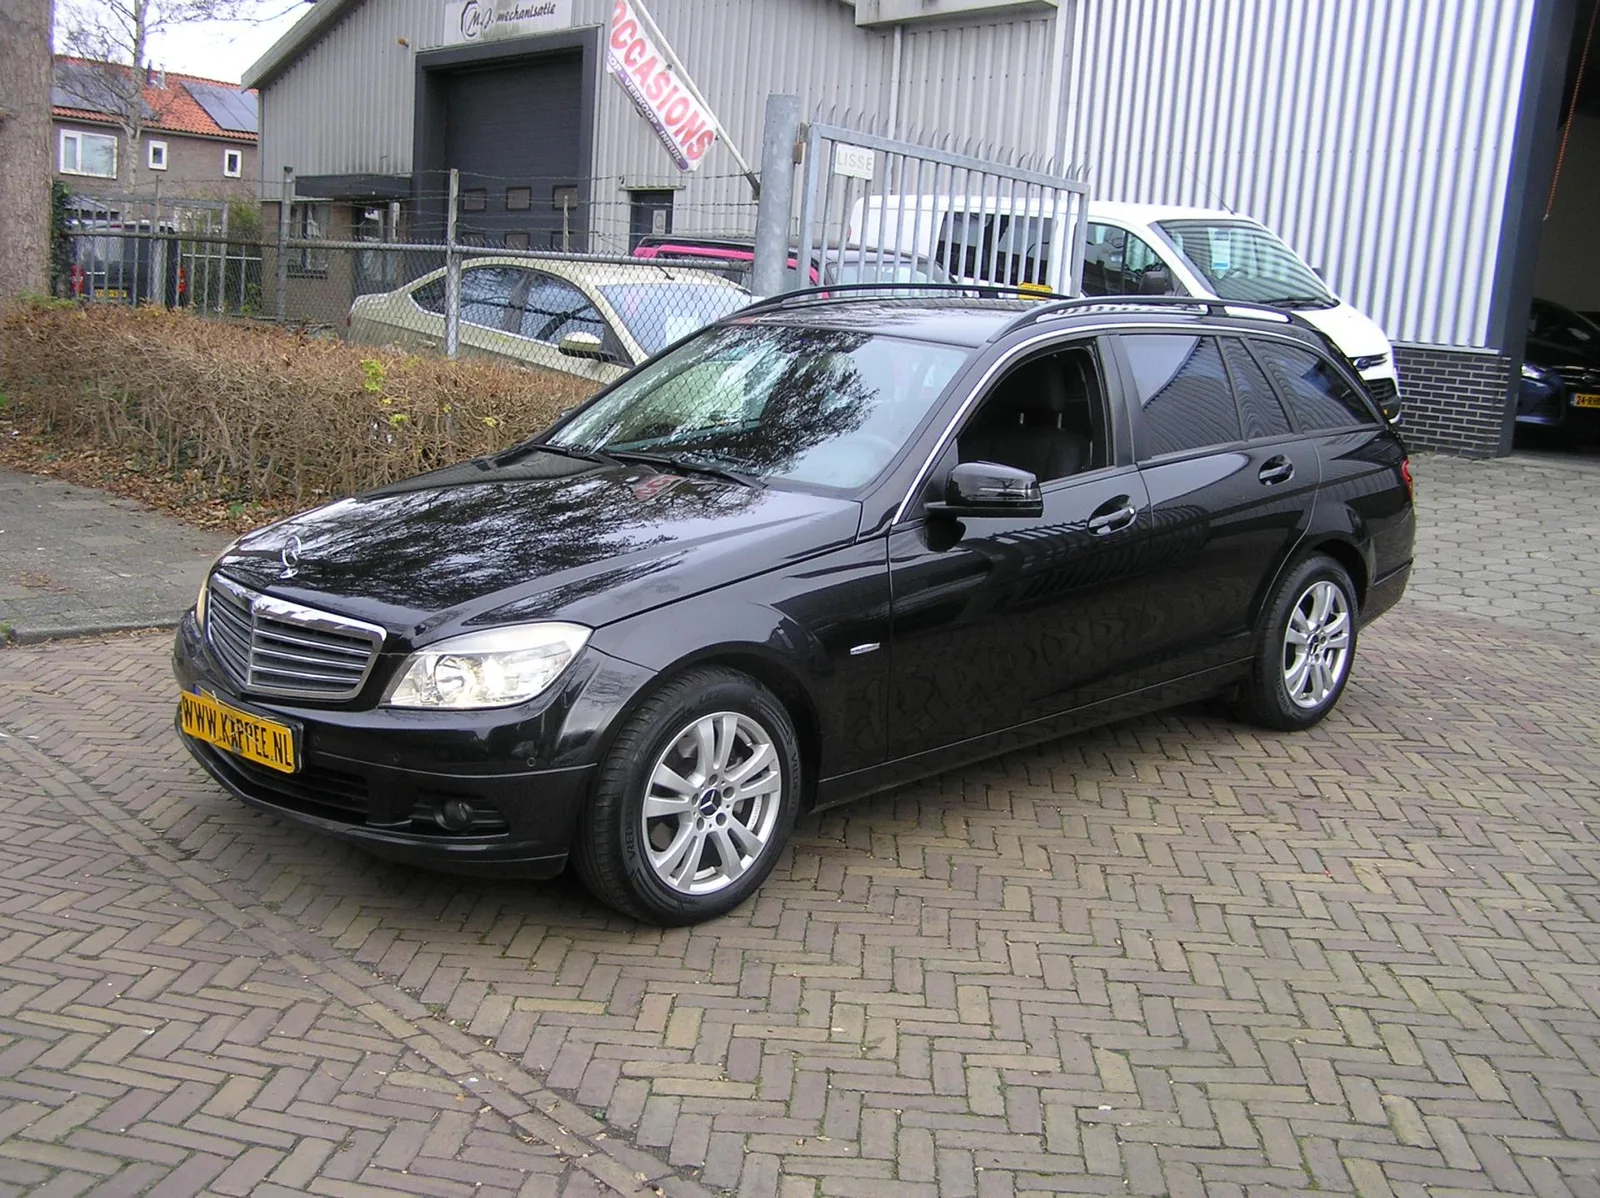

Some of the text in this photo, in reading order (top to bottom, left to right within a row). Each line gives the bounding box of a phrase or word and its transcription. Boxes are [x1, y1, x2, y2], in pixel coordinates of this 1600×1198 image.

[496, 1, 556, 22] mechanisatie
[624, 77, 658, 125] VERKOOP
[658, 129, 683, 163] INRUIL
[837, 151, 873, 171] LISSE
